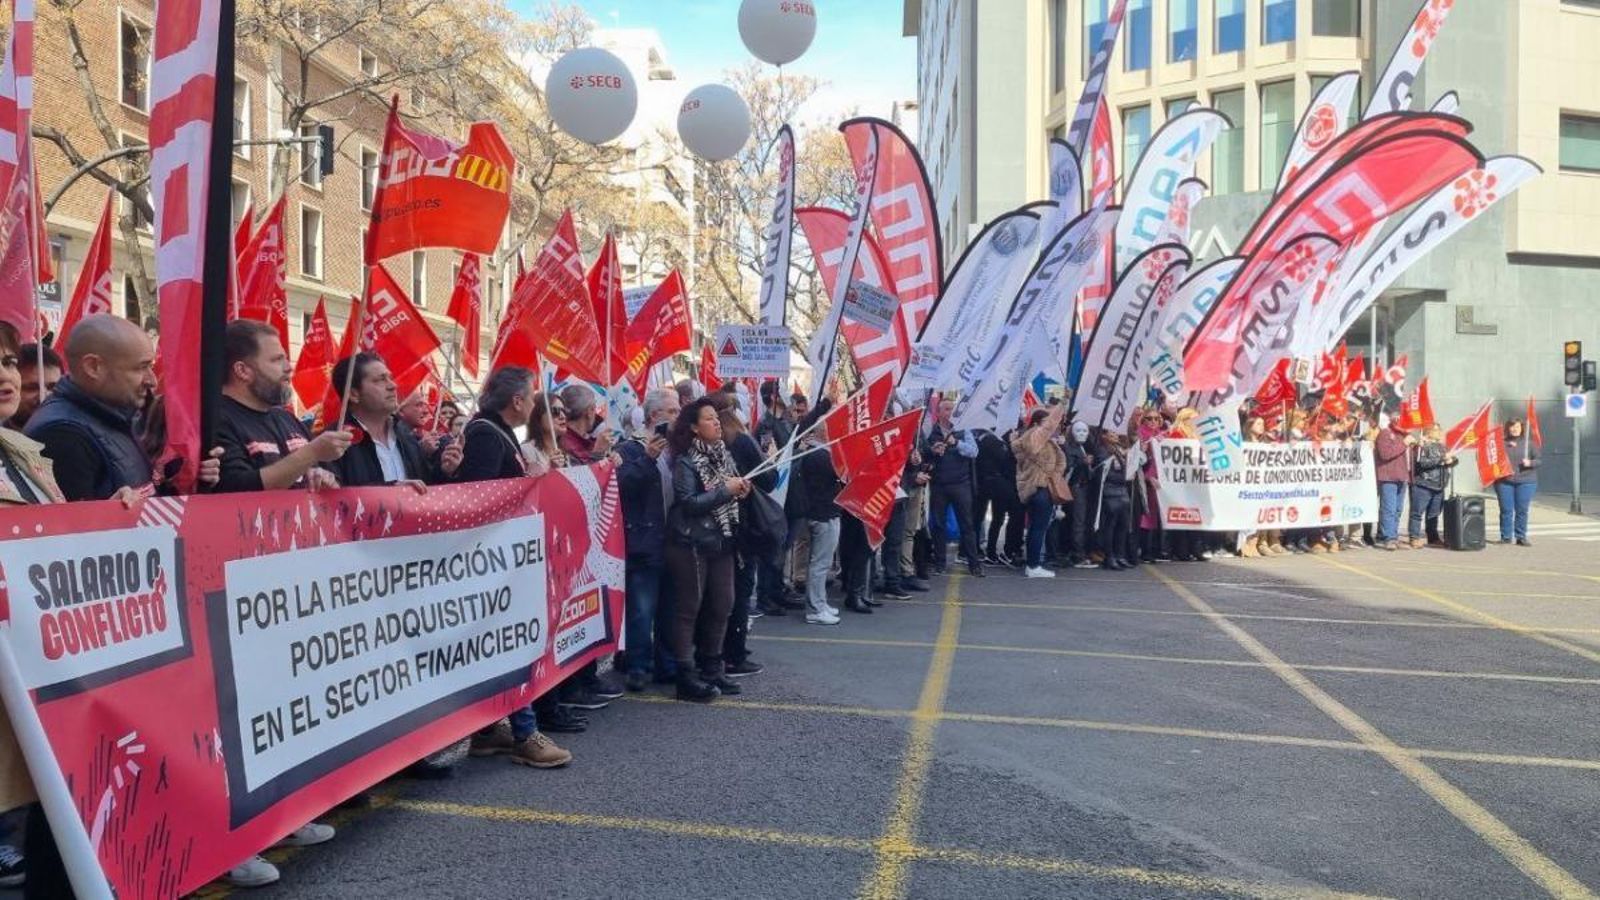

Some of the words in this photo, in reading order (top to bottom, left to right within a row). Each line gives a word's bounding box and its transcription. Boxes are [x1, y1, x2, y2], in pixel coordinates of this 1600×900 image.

[588, 75, 621, 89] SECB
[1160, 446, 1193, 465] POR
[1197, 415, 1230, 471] fine
[1173, 468, 1187, 483] LA
[1245, 469, 1260, 484] DE
[1258, 507, 1284, 524] UGT
[28, 551, 141, 610] SALARIO
[236, 588, 289, 635] POR
[294, 581, 325, 619] LA
[330, 543, 508, 609] RECUPERACIÓN
[512, 538, 543, 569] DEL
[39, 592, 167, 661] CONFLICTO
[290, 622, 369, 678] PODER
[374, 585, 512, 649] ADQUISITIVO
[251, 707, 285, 755] EN
[290, 695, 321, 736] EL
[325, 658, 411, 720] SECTOR
[415, 617, 541, 683] FINANCIERO
